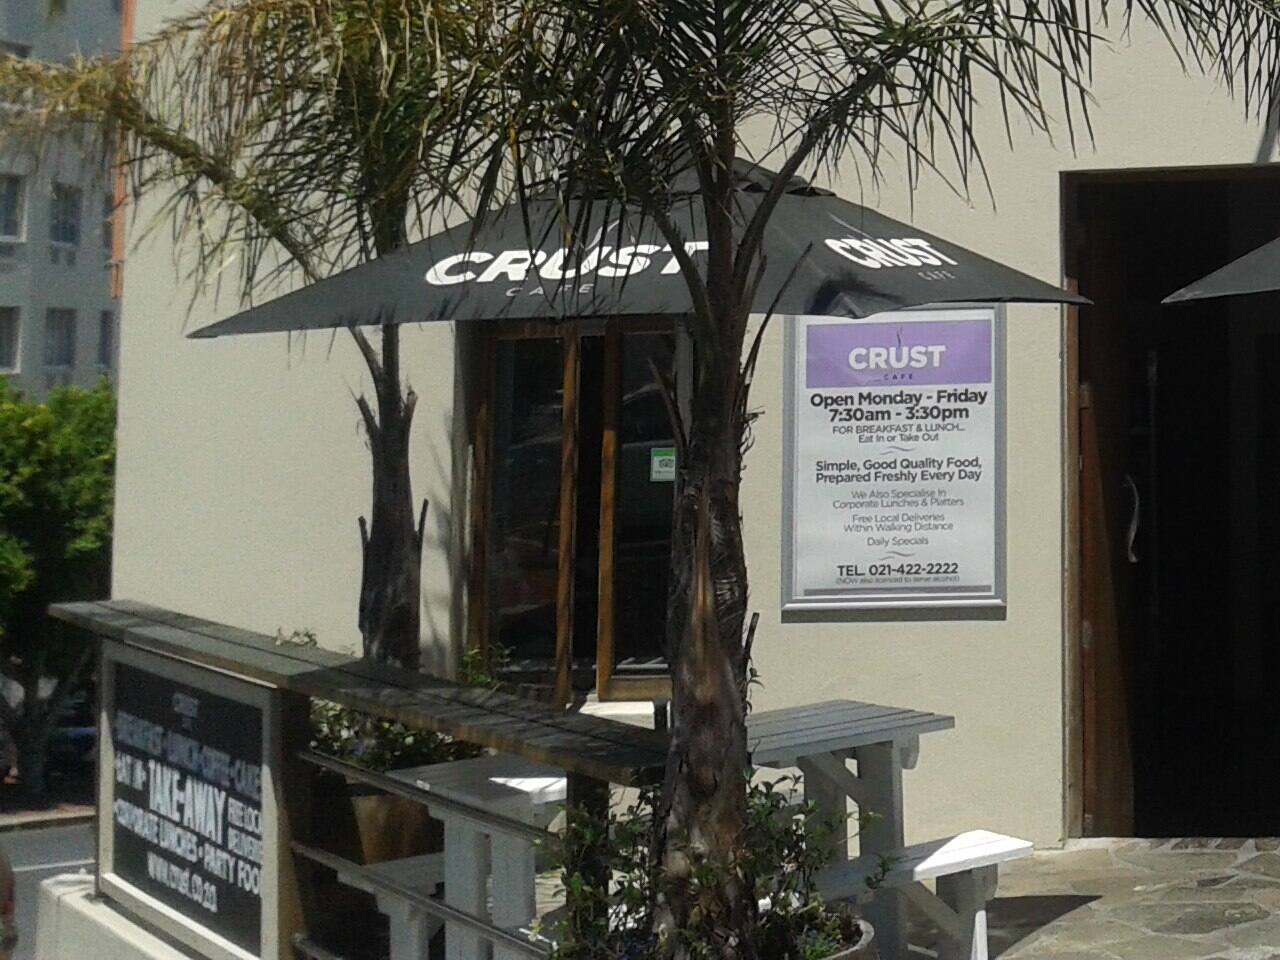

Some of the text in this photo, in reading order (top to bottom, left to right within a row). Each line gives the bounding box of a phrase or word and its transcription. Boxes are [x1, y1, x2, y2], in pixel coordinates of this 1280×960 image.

[823, 237, 960, 269] CRUST
[424, 241, 709, 287] CRUST
[848, 345, 947, 370] CRUST
[884, 373, 913, 381] CAFE
[810, 392, 854, 410] Open
[859, 391, 923, 407] Monday
[937, 389, 988, 405] Friday
[829, 407, 891, 422] 7:30am
[905, 406, 969, 422] 3:30pm
[832, 425, 853, 435] FOR
[856, 424, 914, 434] BREAKFAST
[916, 424, 922, 432] &
[858, 434, 874, 443] Eat
[876, 433, 885, 442] In
[900, 433, 920, 442] Take
[922, 433, 939, 441] Out
[816, 457, 982, 472] Simple, Good Quality Food,
[816, 469, 982, 484] Prepared Freshly Every Day
[851, 489, 947, 500] We Also Specialise In
[832, 500, 879, 510] Corporate
[881, 499, 919, 508] Lunches
[930, 498, 964, 506] Platters
[852, 513, 944, 523] Free Local Deliveries
[843, 522, 953, 533] Within Walking Distance
[867, 537, 929, 548] Daily Specials
[837, 563, 959, 577] TEL. 021-422-2222
[149, 759, 227, 845] TAKE-AWAY
[159, 818, 199, 863] LUNCHES
[204, 842, 236, 884] PARTY
[238, 859, 262, 897] FOO
